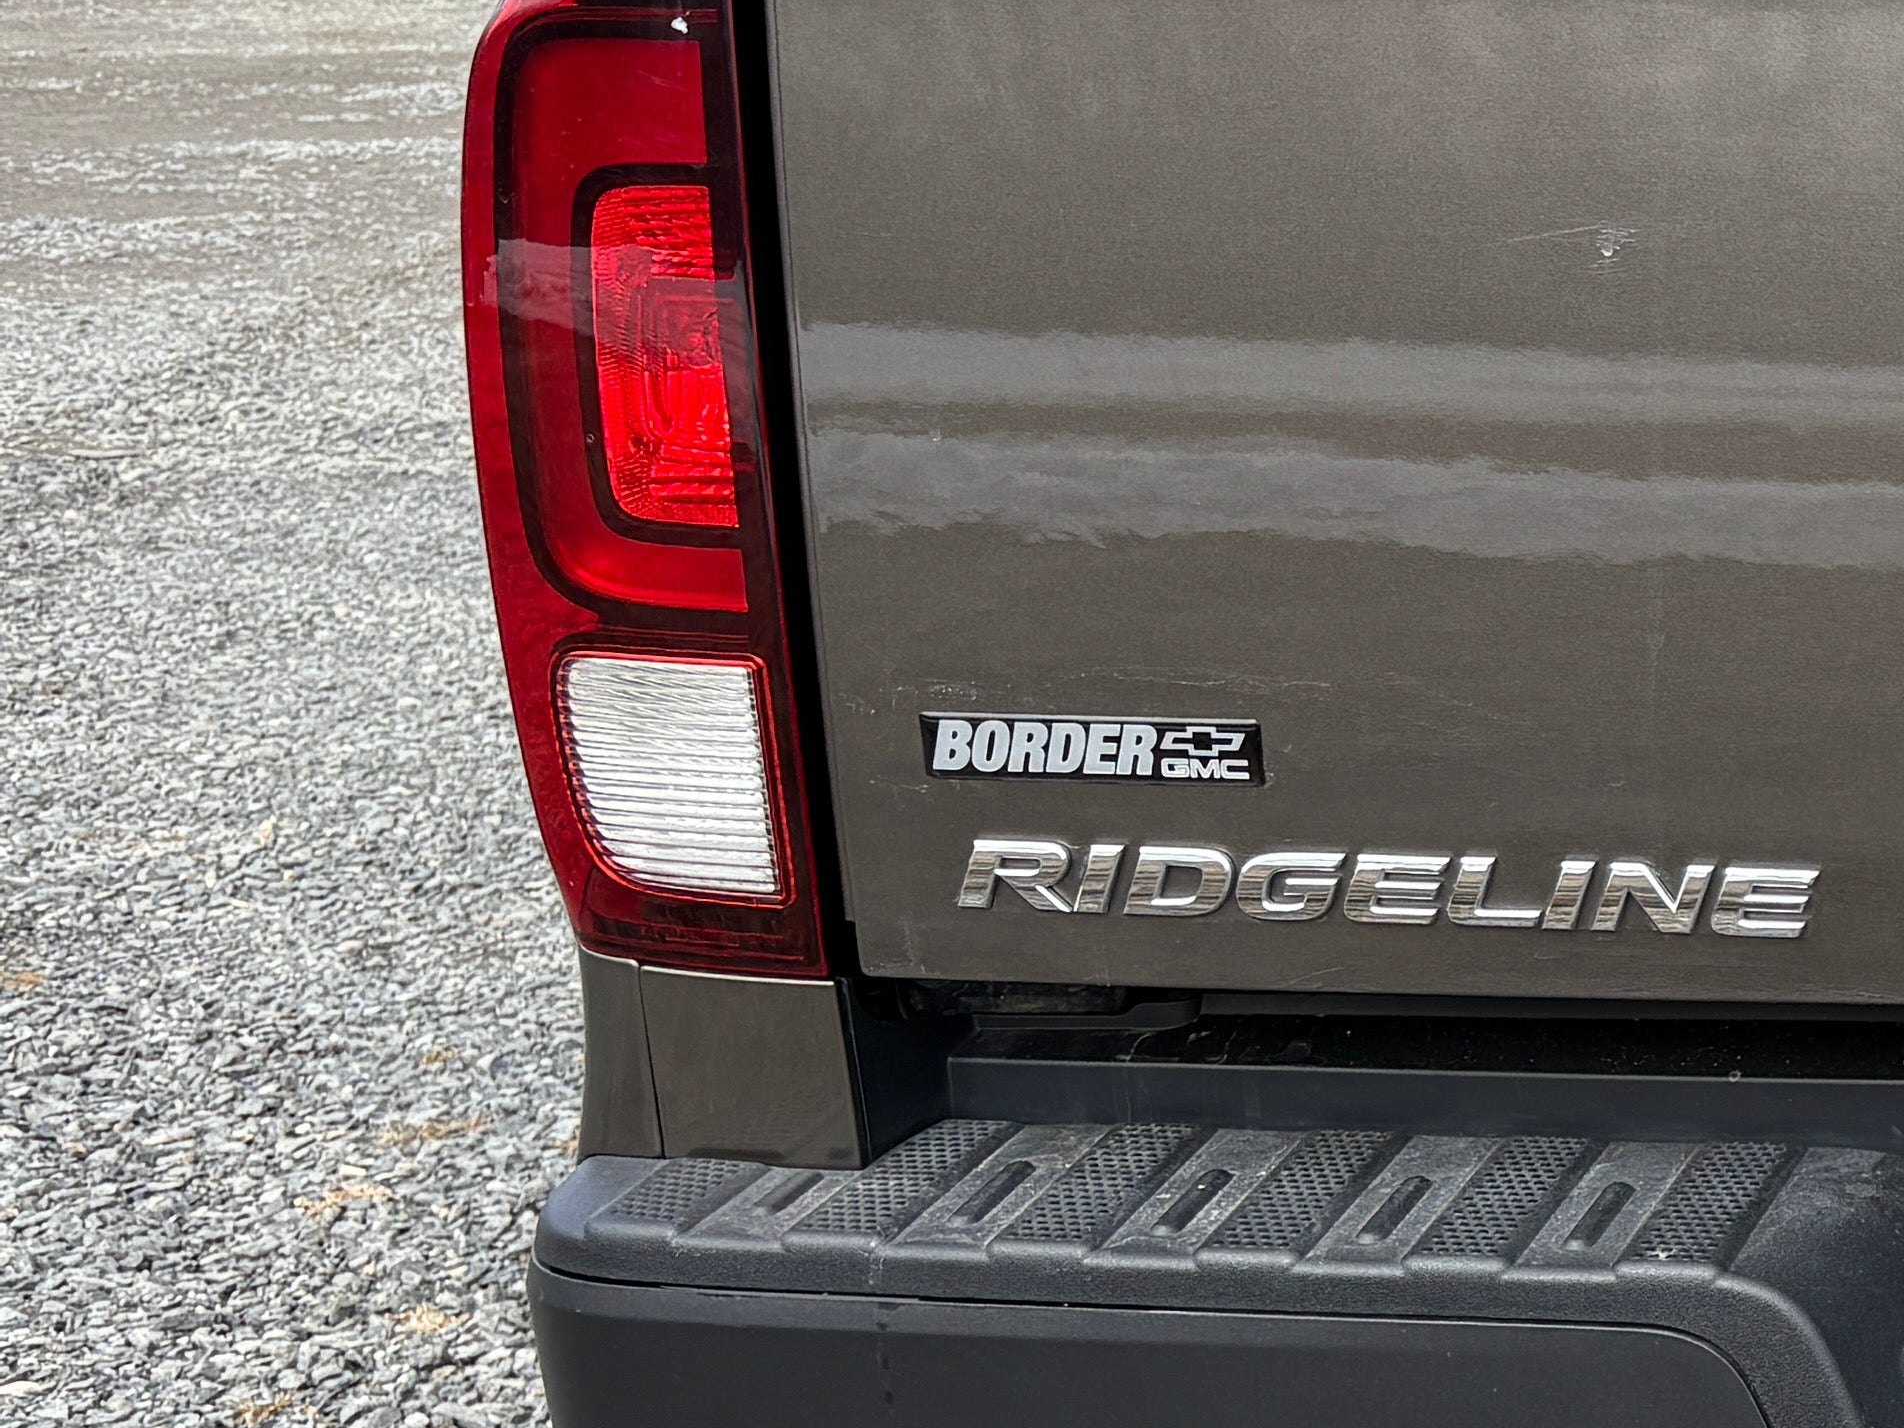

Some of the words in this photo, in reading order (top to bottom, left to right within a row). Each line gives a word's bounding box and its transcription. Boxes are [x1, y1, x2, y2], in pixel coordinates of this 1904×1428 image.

[932, 718, 1159, 776] BORDER
[1160, 757, 1251, 780] GMC
[956, 837, 1822, 940] RIDGELINE
